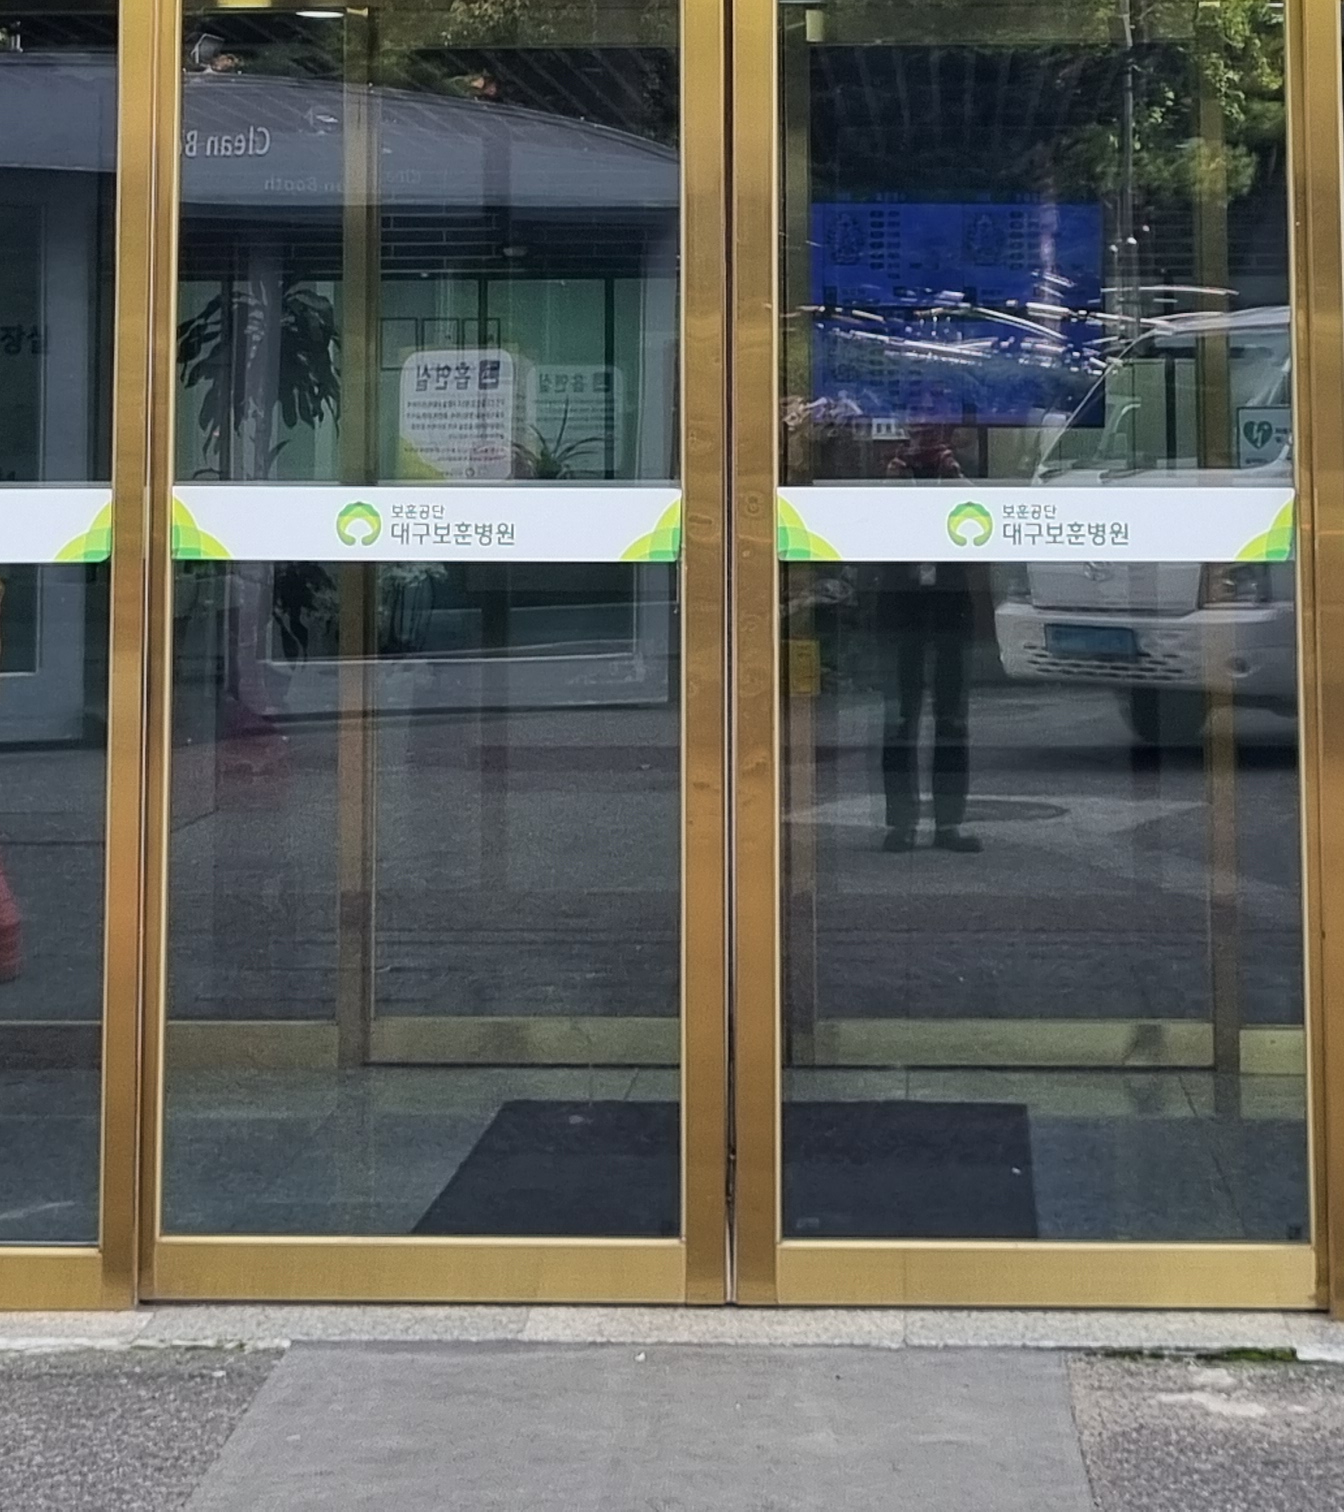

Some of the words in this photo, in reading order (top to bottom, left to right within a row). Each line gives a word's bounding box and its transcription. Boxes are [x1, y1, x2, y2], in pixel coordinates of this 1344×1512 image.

[391, 503, 445, 520] 보훈공단
[1002, 504, 1057, 521] 보훈공단
[390, 521, 515, 547] 대구보훈병원
[1002, 521, 1129, 547] 대구보훈병원
